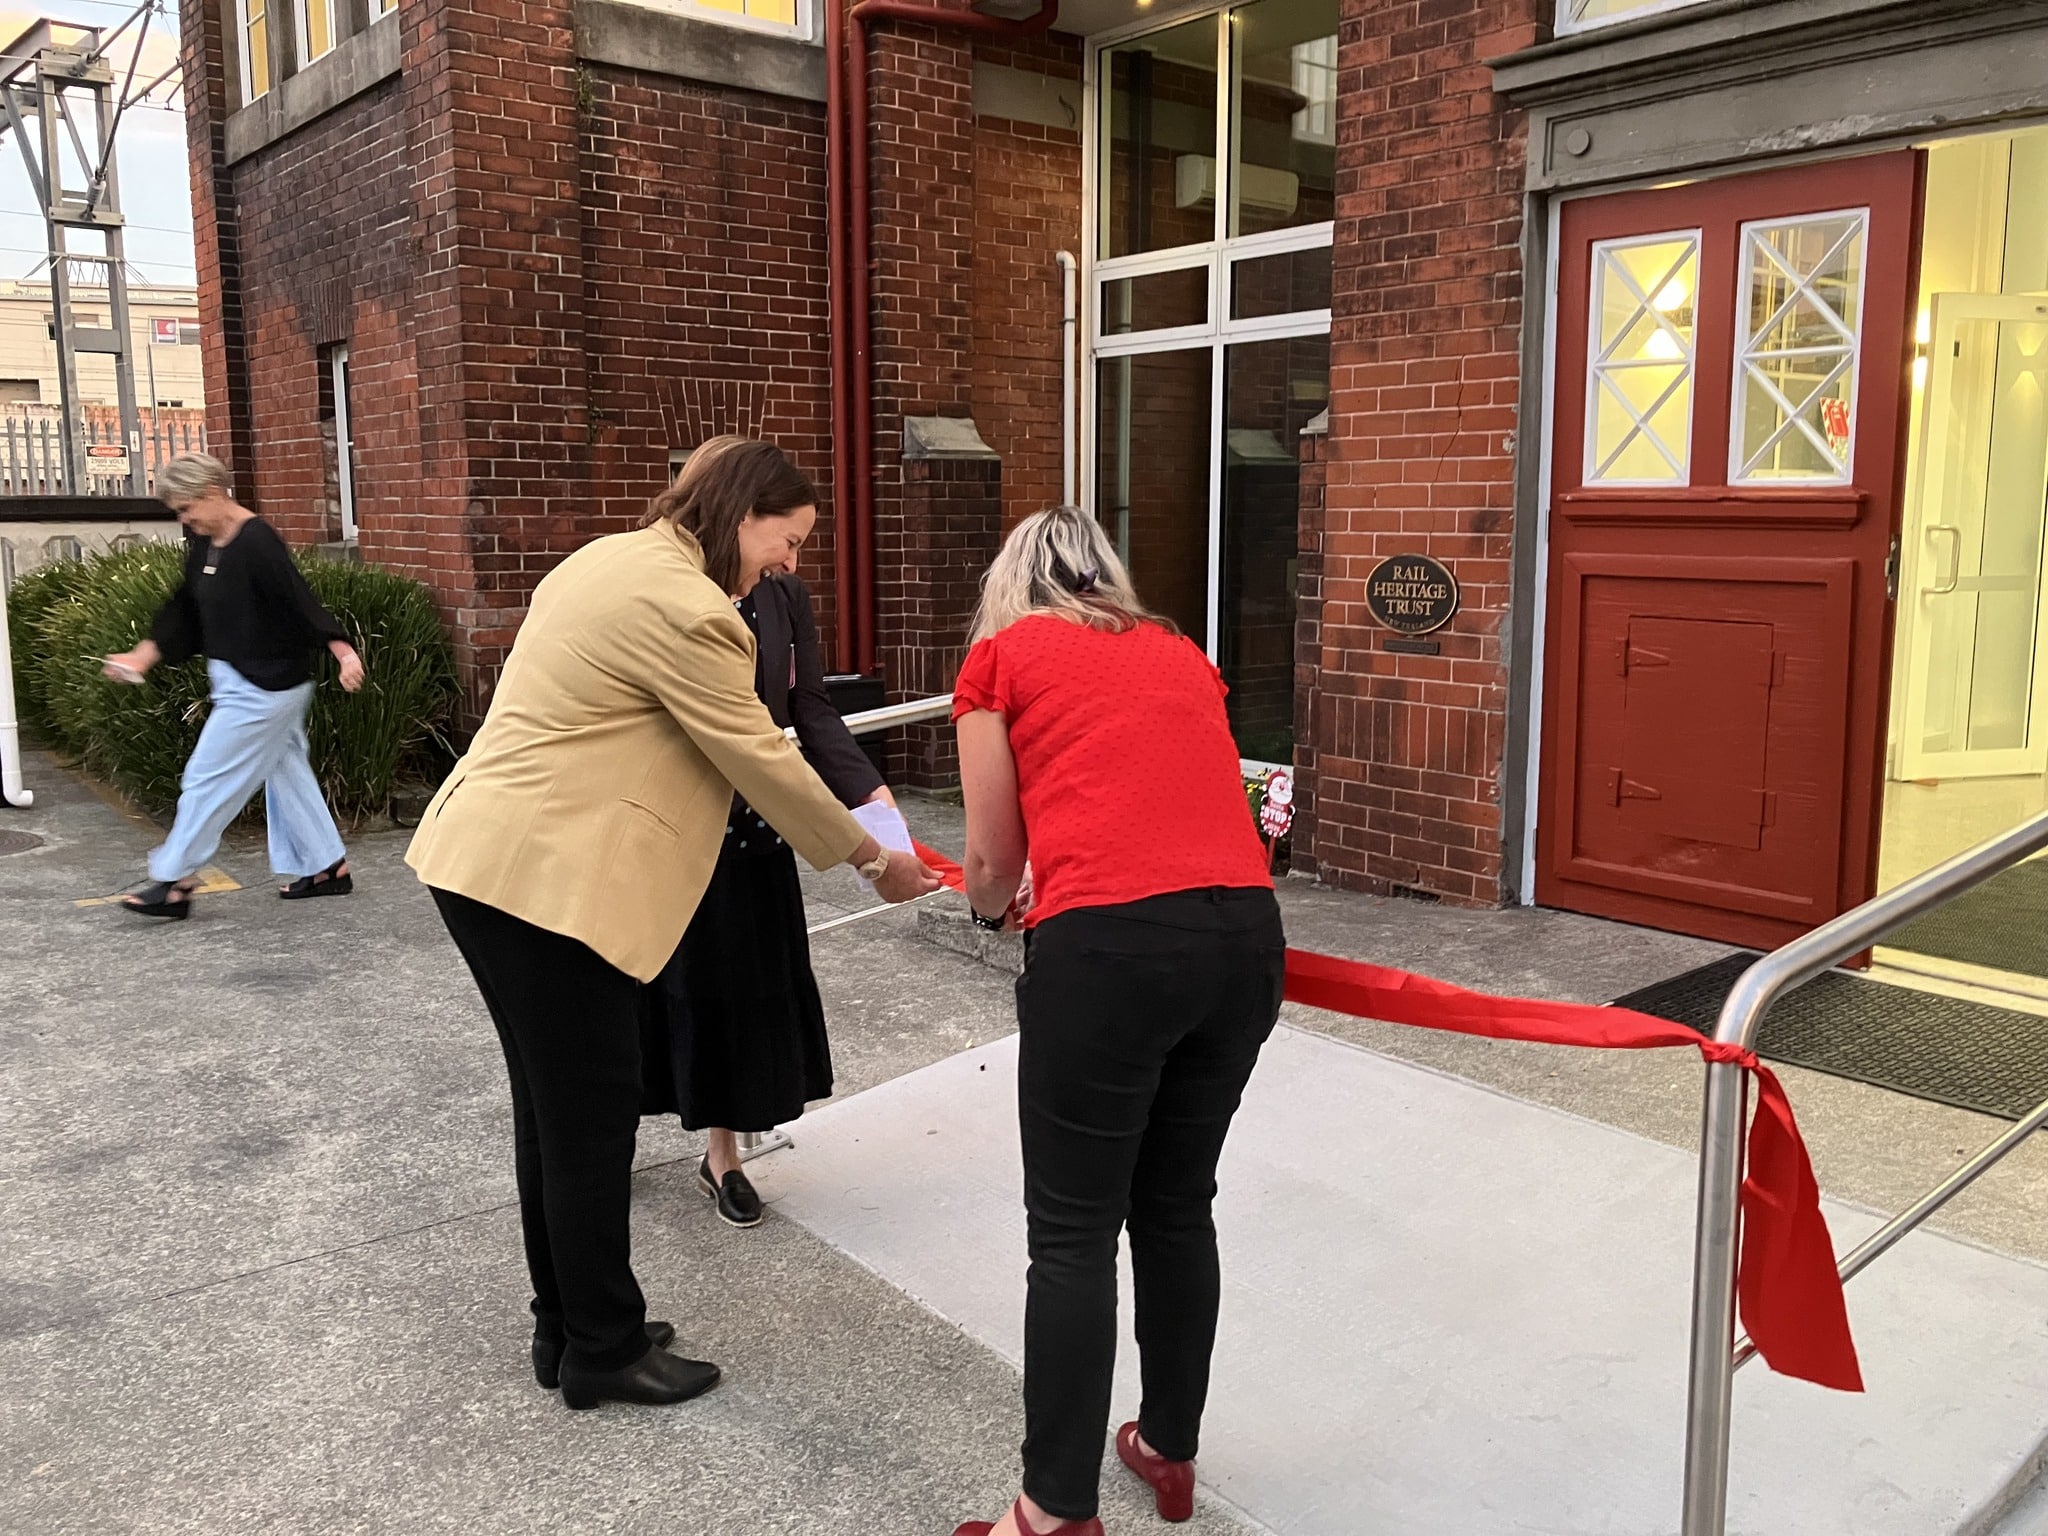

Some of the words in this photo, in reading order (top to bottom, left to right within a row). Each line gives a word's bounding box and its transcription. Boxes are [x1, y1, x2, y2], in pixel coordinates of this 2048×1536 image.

[91, 448, 121, 456] DANGER
[1392, 565, 1429, 581] RAIL
[1373, 582, 1447, 599] HERITAGE
[1385, 599, 1434, 616] TRUST
[1384, 615, 1400, 626] NEW
[1400, 618, 1435, 630] ZEALAND
[1264, 806, 1288, 824] STOP
